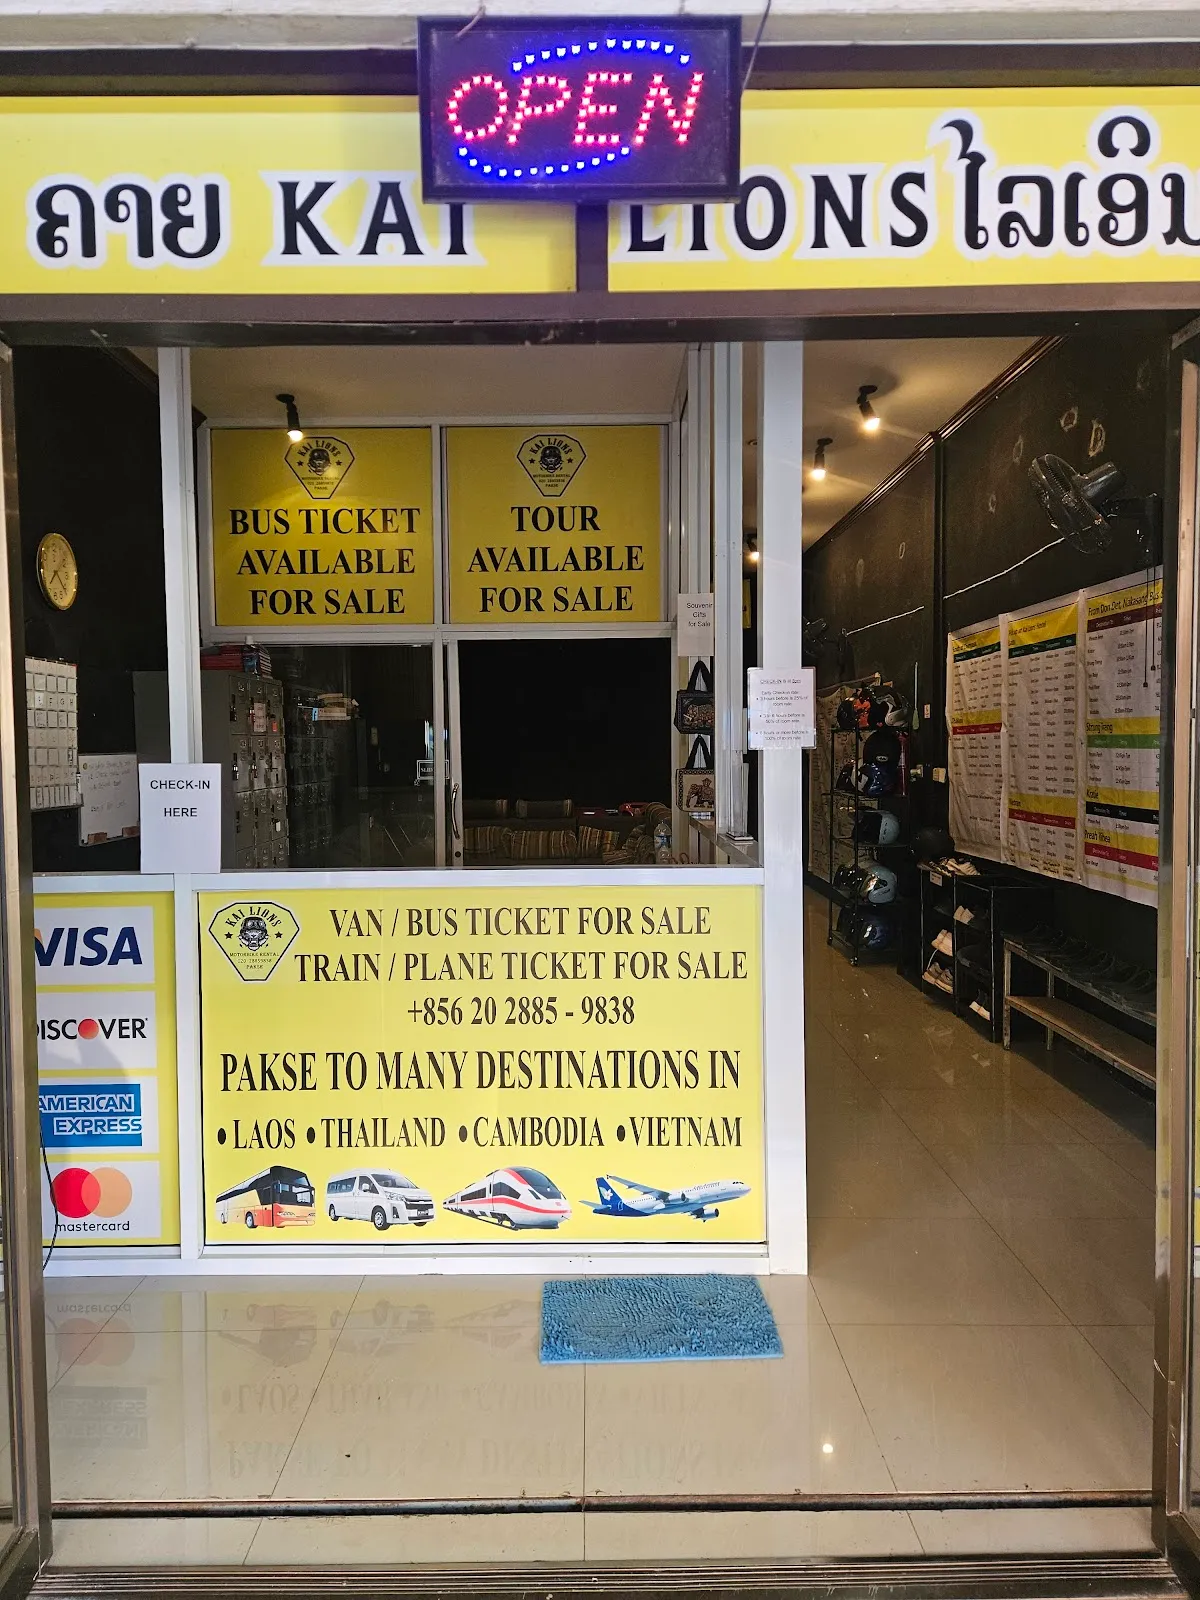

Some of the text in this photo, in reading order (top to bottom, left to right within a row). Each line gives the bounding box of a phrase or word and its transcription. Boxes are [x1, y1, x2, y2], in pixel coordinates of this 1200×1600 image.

[446, 71, 700, 146] OPEN
[279, 181, 467, 256] KAI
[628, 172, 929, 252] LIONS
[230, 508, 421, 535] BUS TICKET
[511, 505, 601, 532] TOUR
[236, 548, 416, 576] AVAILABLE
[467, 545, 644, 573] AVAILABLE
[249, 588, 406, 615] FOR SALE
[479, 585, 634, 613] FOR SALE
[150, 779, 211, 790] CHECK-IN
[163, 807, 198, 817] HERE
[225, 906, 282, 928] KAI LIONS
[329, 906, 711, 938] VAN / BUS TICKET FOR SALE
[34, 926, 143, 967] VISA
[294, 950, 748, 982] TRAIN / PLANE TICKET FOR SALE
[407, 996, 463, 1026] +856
[470, 996, 497, 1025] 20
[504, 996, 558, 1025] 2885
[581, 995, 635, 1025] 9838
[36, 1018, 147, 1040] ISCOVER
[219, 1049, 741, 1092] PAKSE TO MANY DESTINATIONS IN
[39, 1093, 135, 1113] AMERICAN
[54, 1116, 142, 1136] EXPRESS
[232, 1116, 743, 1150] LAOS THAILAND CAMBODIA VIETNAM
[55, 1221, 130, 1233] mastercard
